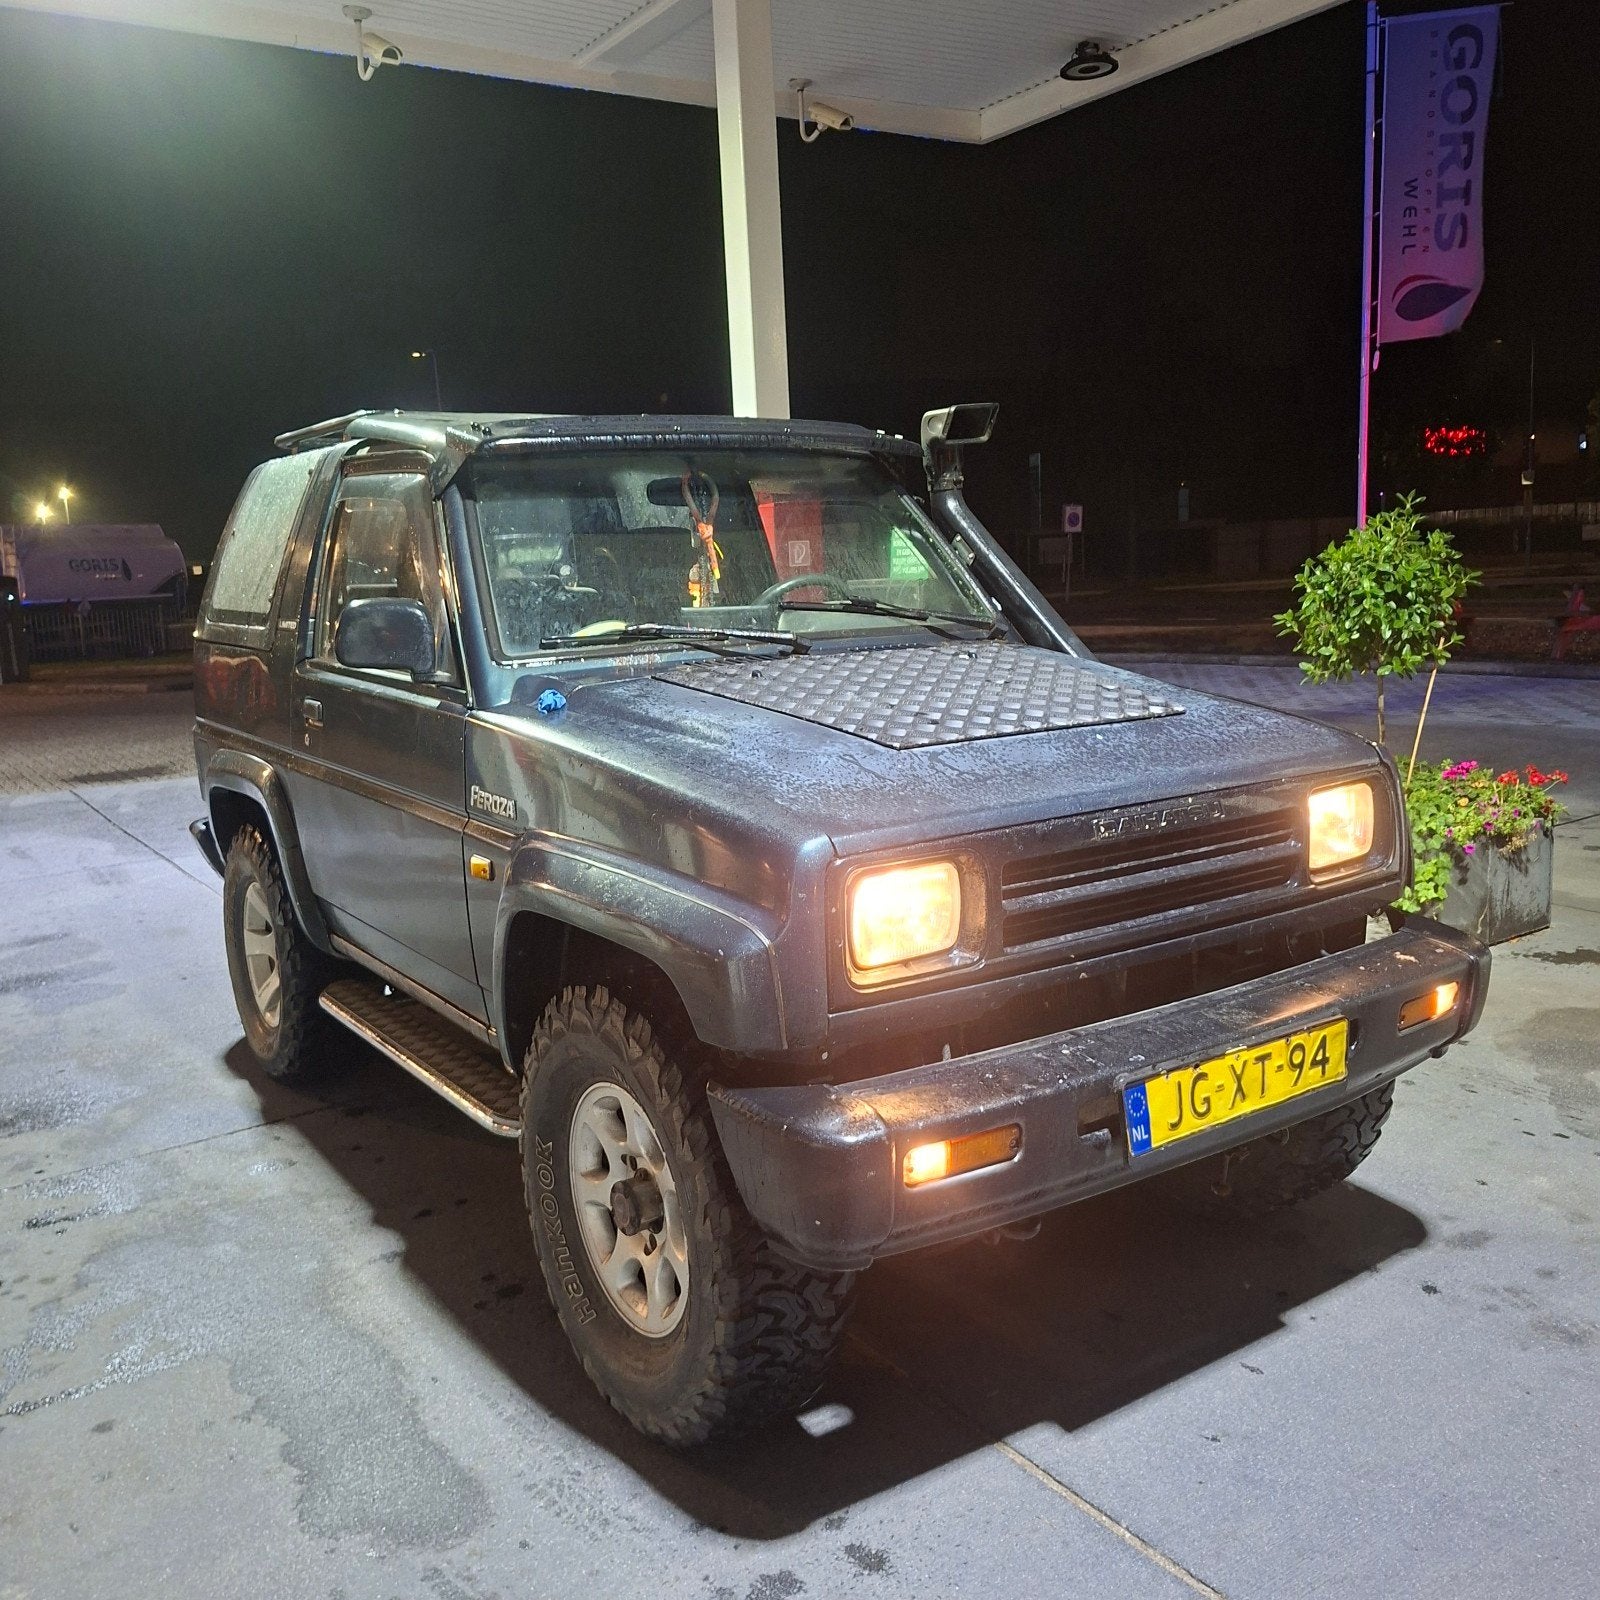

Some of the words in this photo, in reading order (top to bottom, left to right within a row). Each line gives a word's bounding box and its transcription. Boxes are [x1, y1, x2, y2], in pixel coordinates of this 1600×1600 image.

[1434, 24, 1484, 252] GORIS
[1402, 178, 1419, 255] WEHL
[68, 557, 120, 573] GORIS
[470, 785, 516, 819] FEROZA
[1166, 1033, 1330, 1132] JG-XT-94
[1132, 1124, 1149, 1143] NL
